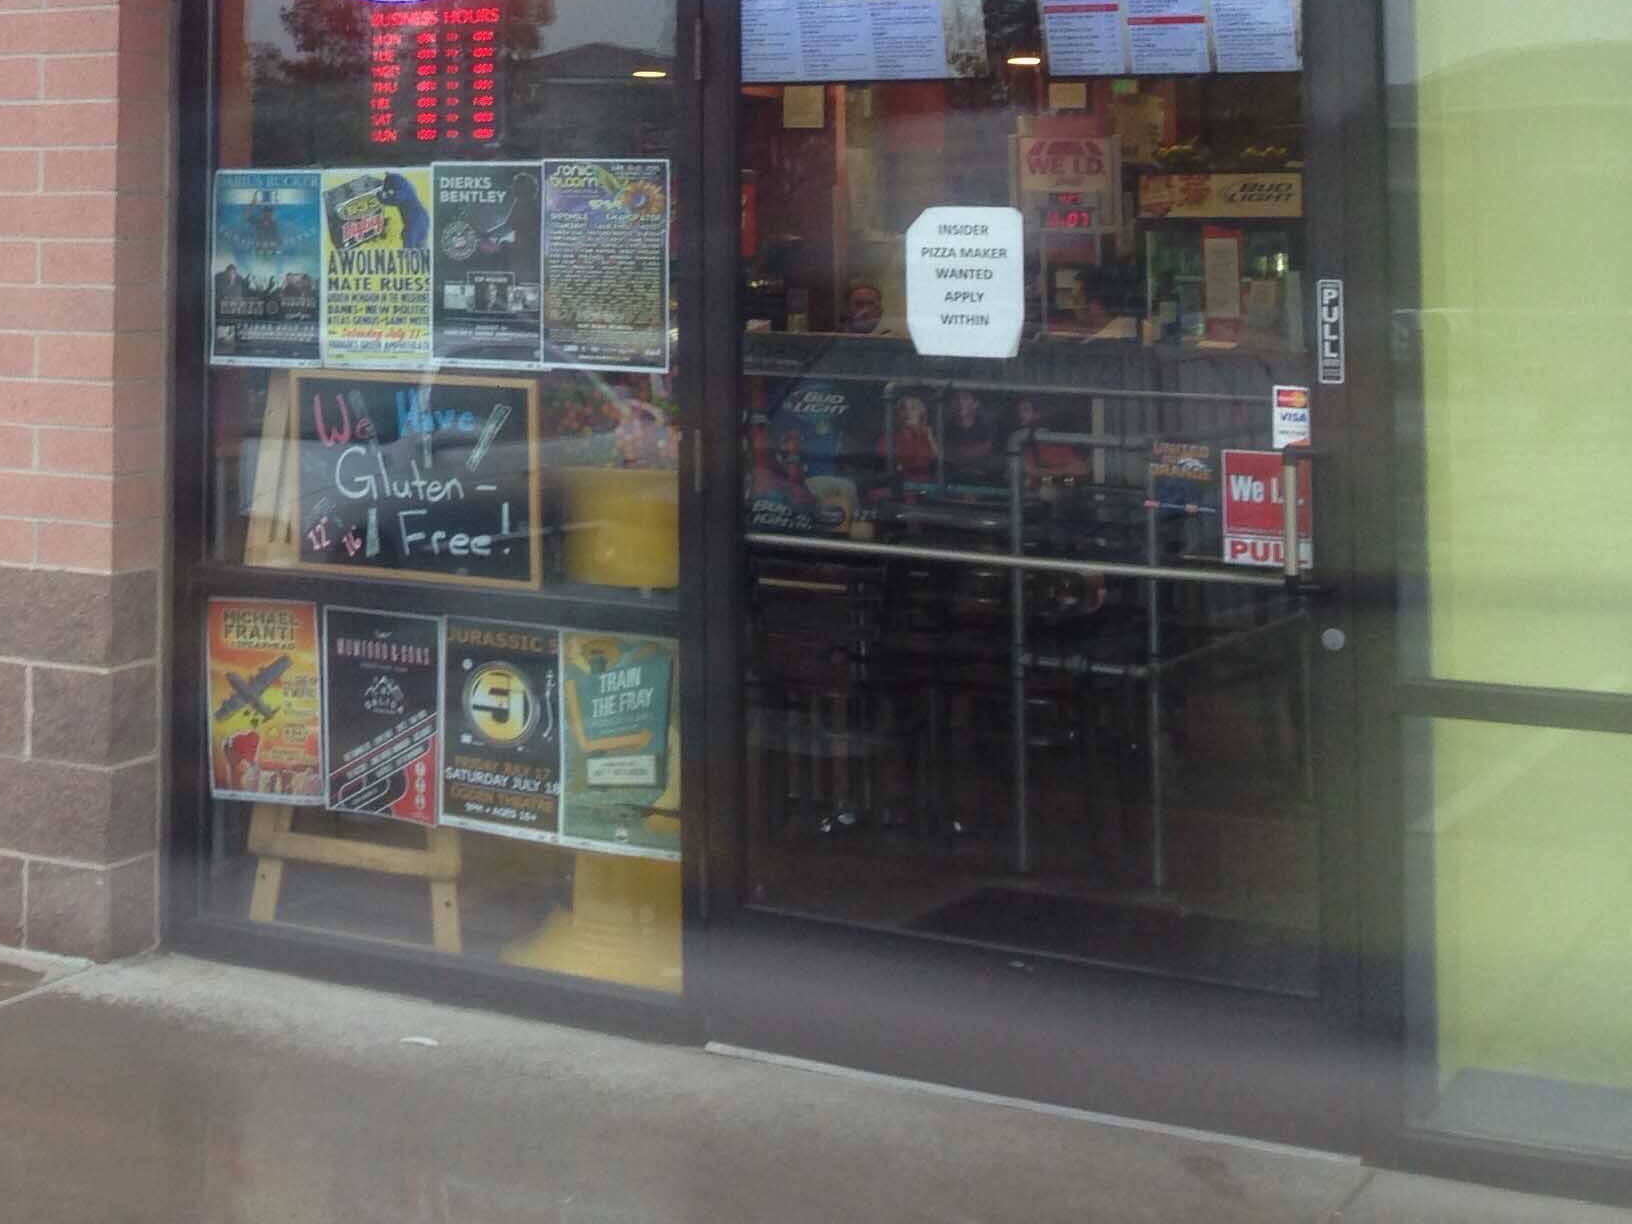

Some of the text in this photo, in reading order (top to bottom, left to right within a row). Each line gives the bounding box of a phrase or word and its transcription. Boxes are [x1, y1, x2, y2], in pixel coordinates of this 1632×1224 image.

[443, 8, 500, 24] HOURS
[440, 176, 492, 189] DIERKS
[1239, 183, 1293, 192] BUD
[440, 190, 507, 203] BENTLEY
[1226, 192, 1296, 203] LIGHT
[938, 224, 989, 236] INSIDER
[921, 247, 1008, 259] PIZZA MAKER
[329, 249, 431, 275] AWOLNATION
[935, 268, 993, 280] WANTED
[328, 277, 371, 290] NATE
[944, 291, 985, 303] APPLY
[940, 313, 990, 326] WITHIN
[1323, 289, 1338, 358] PULL
[802, 392, 846, 404] BUD
[792, 402, 850, 415] LIGHT
[314, 393, 376, 448] We
[1280, 412, 1307, 423] VISA
[1231, 475, 1264, 503] We
[399, 502, 512, 556] Free!
[224, 610, 298, 625] MICHAEL
[447, 628, 543, 652] JURASSIC
[600, 666, 642, 694] TRAIN
[592, 688, 654, 718] THE FRAY
[445, 767, 508, 788] SATURDAY
[512, 776, 541, 792] JULY
